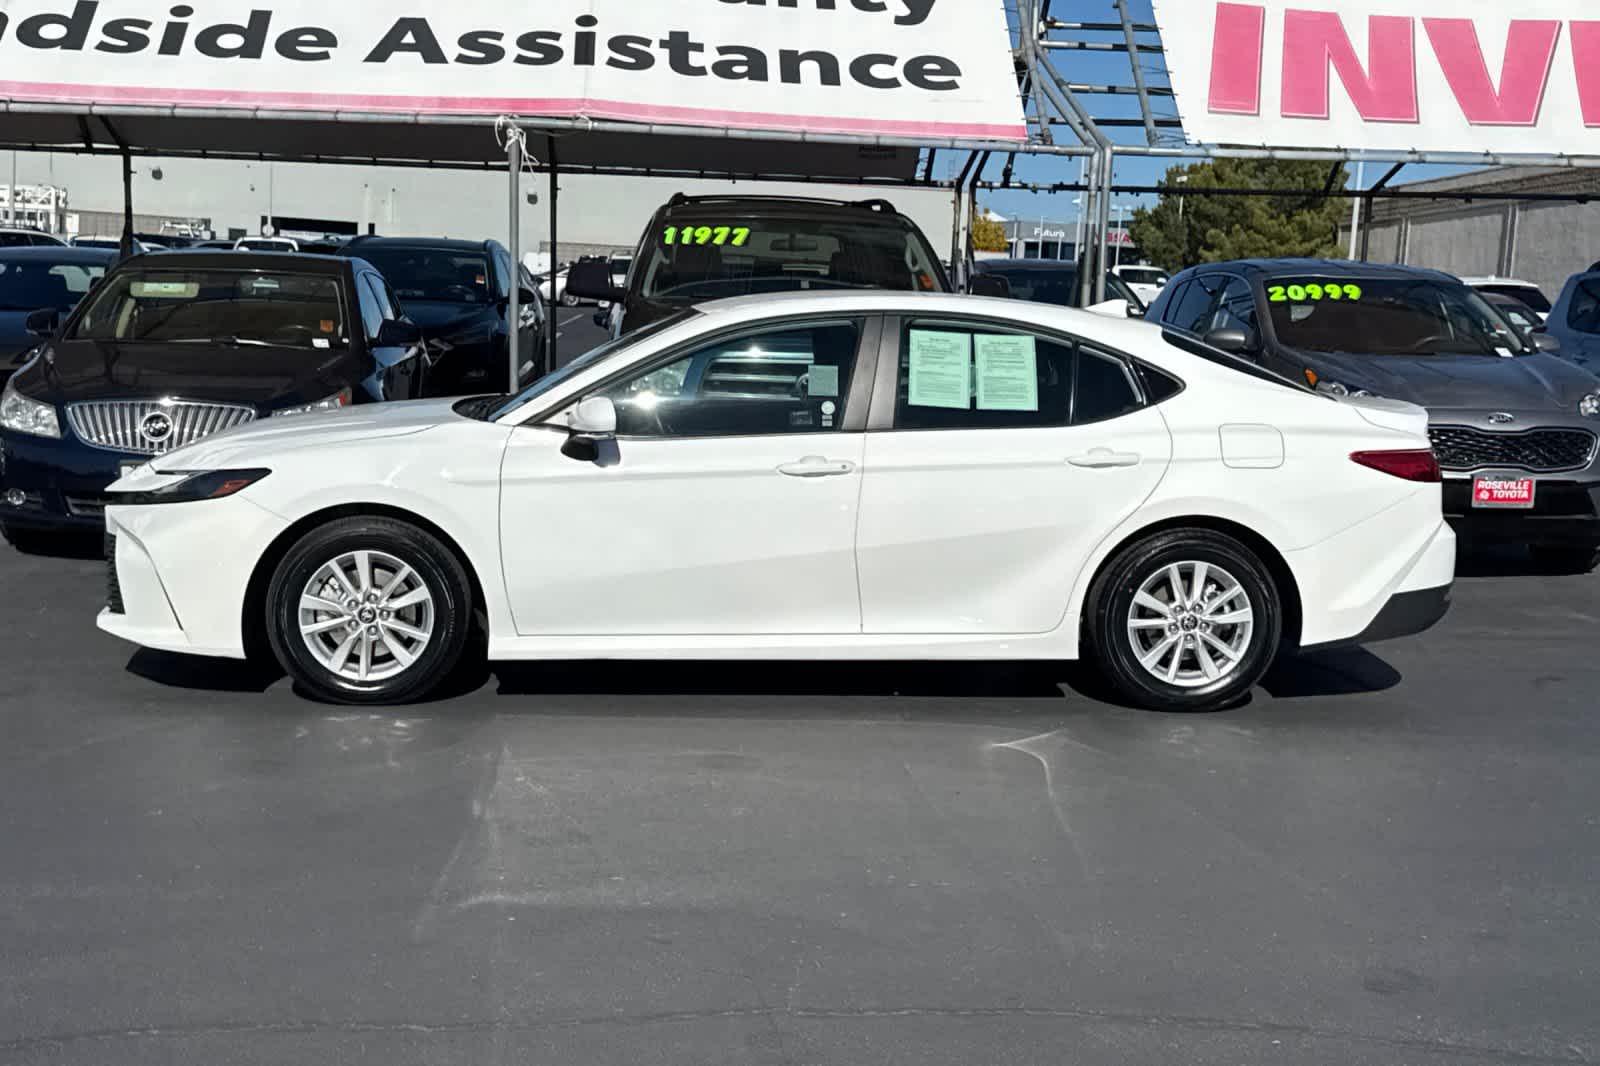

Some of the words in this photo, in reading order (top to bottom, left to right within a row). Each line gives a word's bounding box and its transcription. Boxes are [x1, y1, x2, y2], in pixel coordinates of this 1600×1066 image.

[0, 0, 338, 62] dside
[363, 14, 963, 91] Assistance
[1207, 2, 1600, 127] INV
[663, 226, 751, 247] 11977
[1267, 284, 1362, 302] 20999
[1477, 480, 1530, 490] ROSEVILLE
[1492, 490, 1529, 499] TOYOTA
